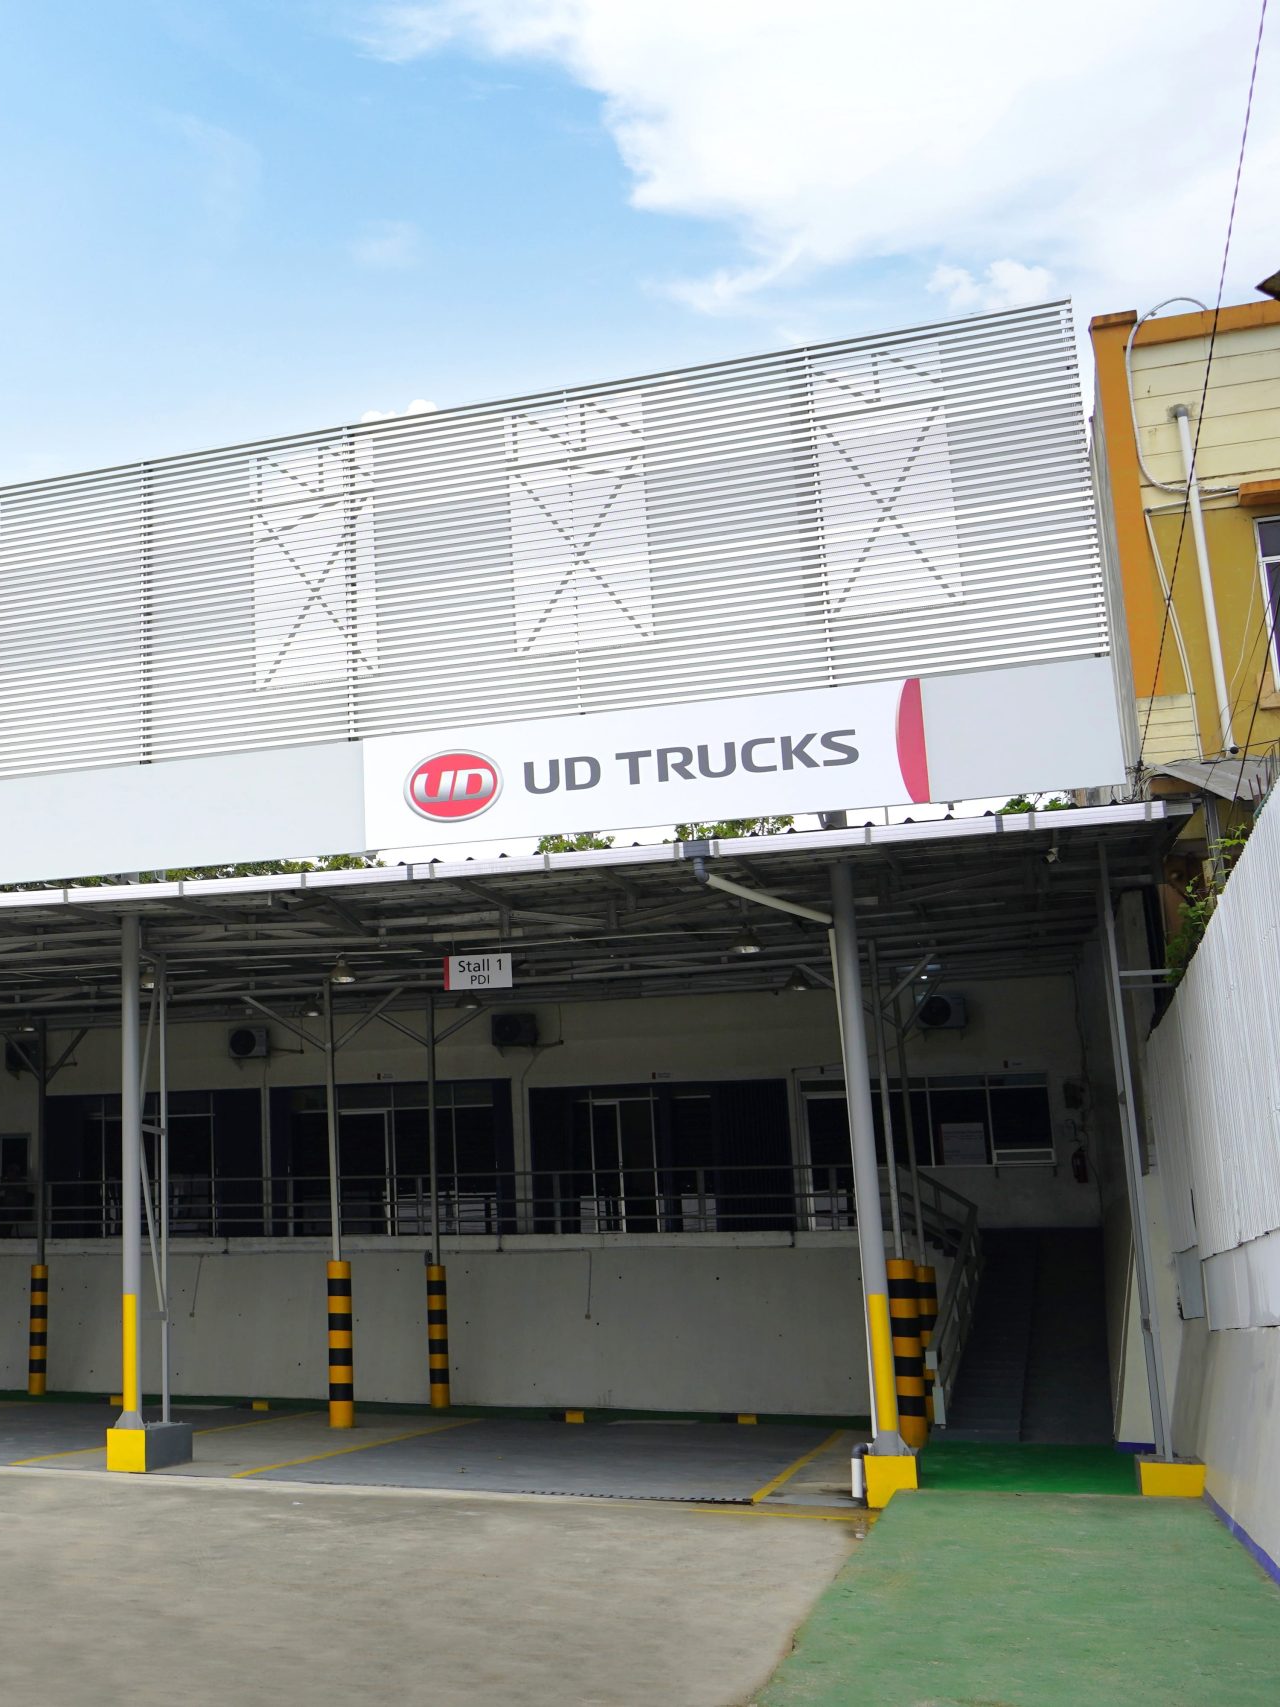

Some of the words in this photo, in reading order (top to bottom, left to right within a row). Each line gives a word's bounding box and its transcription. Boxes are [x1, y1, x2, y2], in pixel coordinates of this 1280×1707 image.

[523, 756, 601, 795] UD
[615, 729, 860, 785] TRUCKS
[413, 768, 494, 803] UD
[458, 958, 490, 973] Stall
[496, 958, 502, 971] 1
[470, 974, 490, 985] PDI
